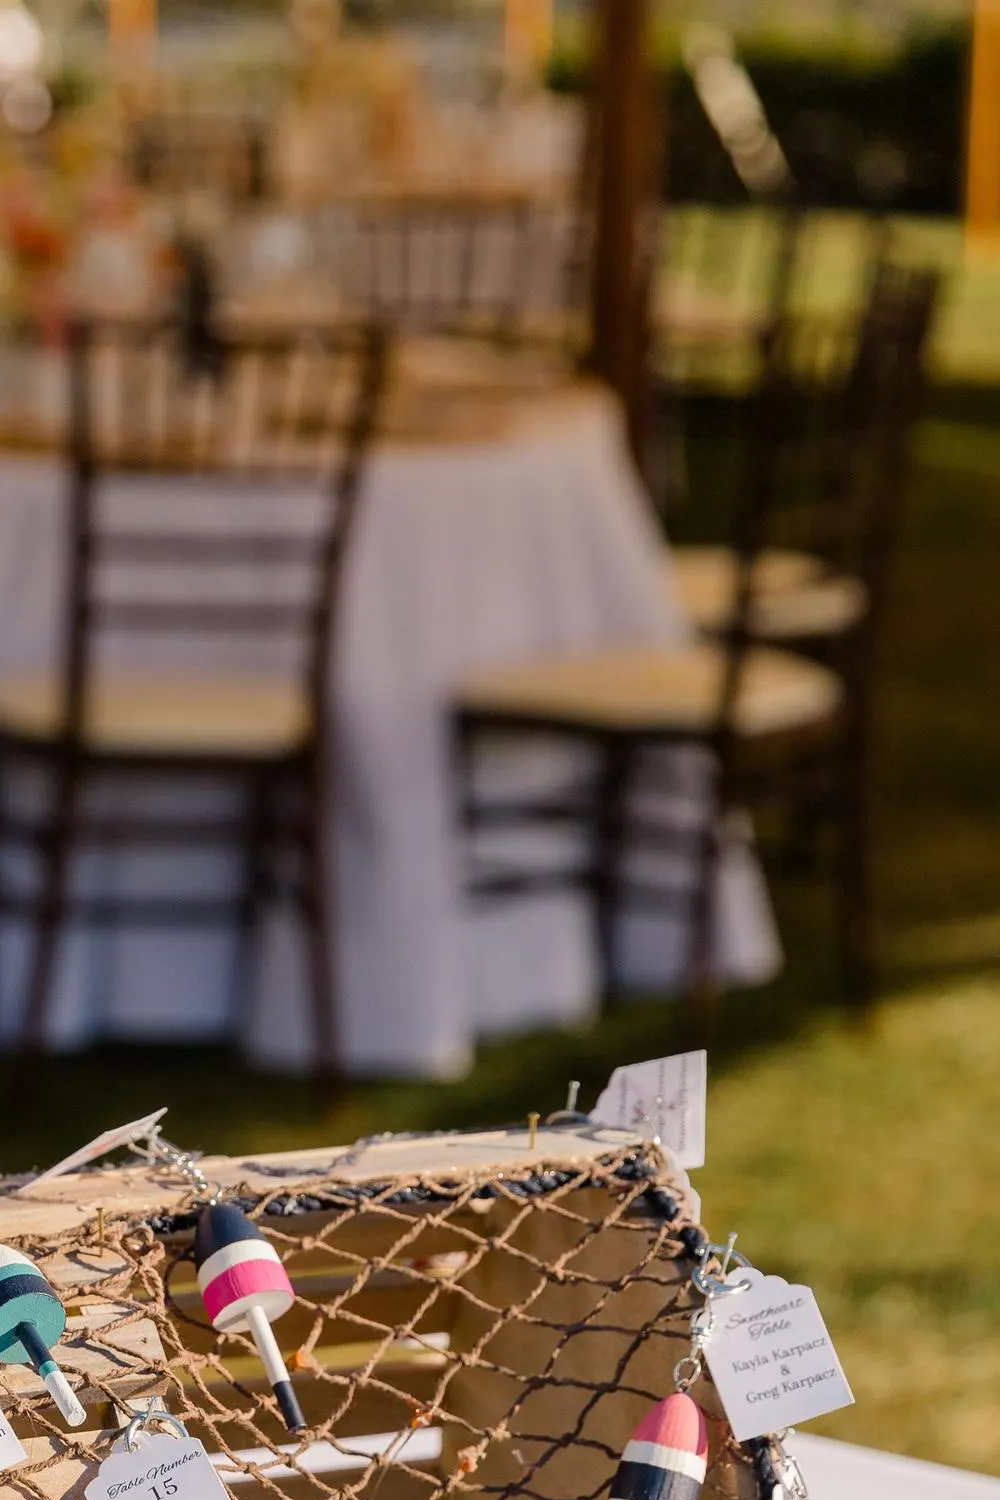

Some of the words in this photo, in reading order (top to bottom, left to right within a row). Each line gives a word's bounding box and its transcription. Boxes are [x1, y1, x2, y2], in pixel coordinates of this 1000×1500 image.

[724, 1297, 806, 1329] Sweetheart
[748, 1319, 792, 1341] Table
[732, 1354, 769, 1374] Kayla
[772, 1337, 828, 1362] Karpacz
[780, 1364, 791, 1376] &
[745, 1387, 780, 1404] Greg
[782, 1368, 838, 1393] Karpacz
[106, 1477, 145, 1499] Table
[146, 1450, 202, 1480] Number
